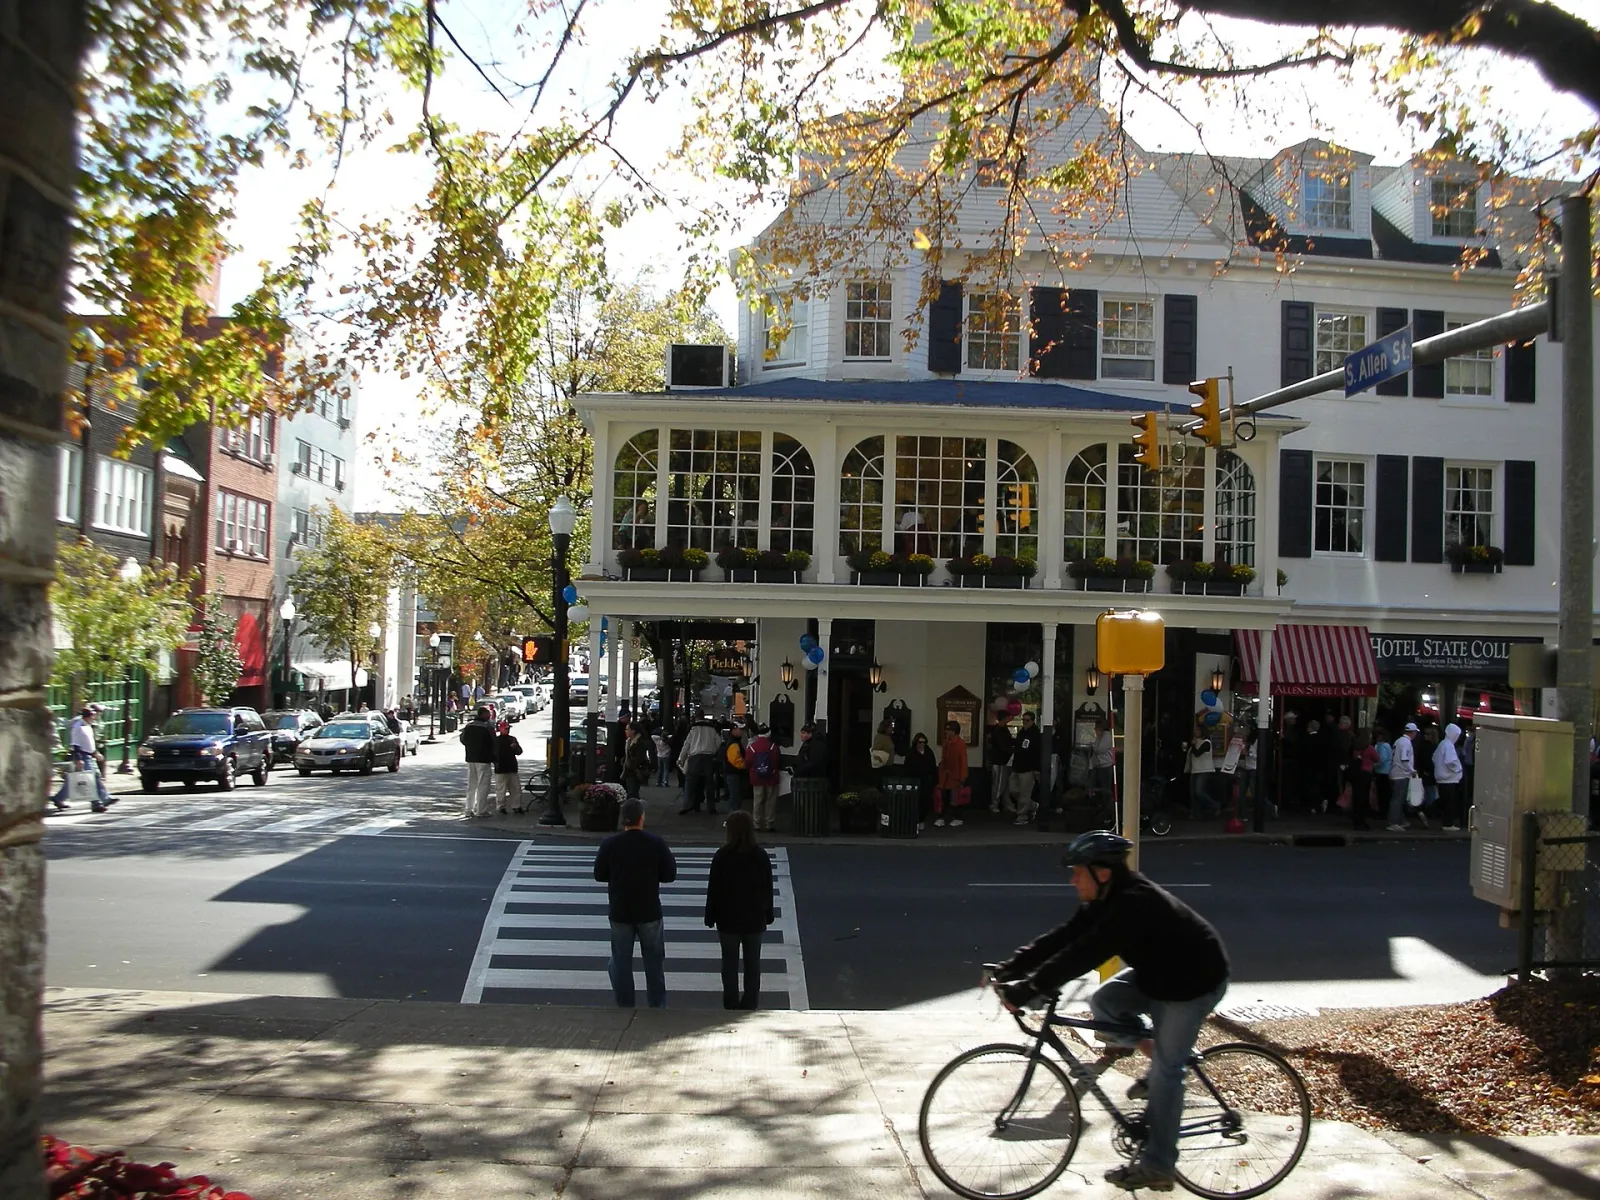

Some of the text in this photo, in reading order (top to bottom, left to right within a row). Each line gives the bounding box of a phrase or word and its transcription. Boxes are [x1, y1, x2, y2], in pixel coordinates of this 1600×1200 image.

[1346, 337, 1410, 387] S. Allen St.
[1370, 637, 1513, 659] HOTEL STATE COLL
[1275, 684, 1366, 695] ALLEN STREET GRILL
